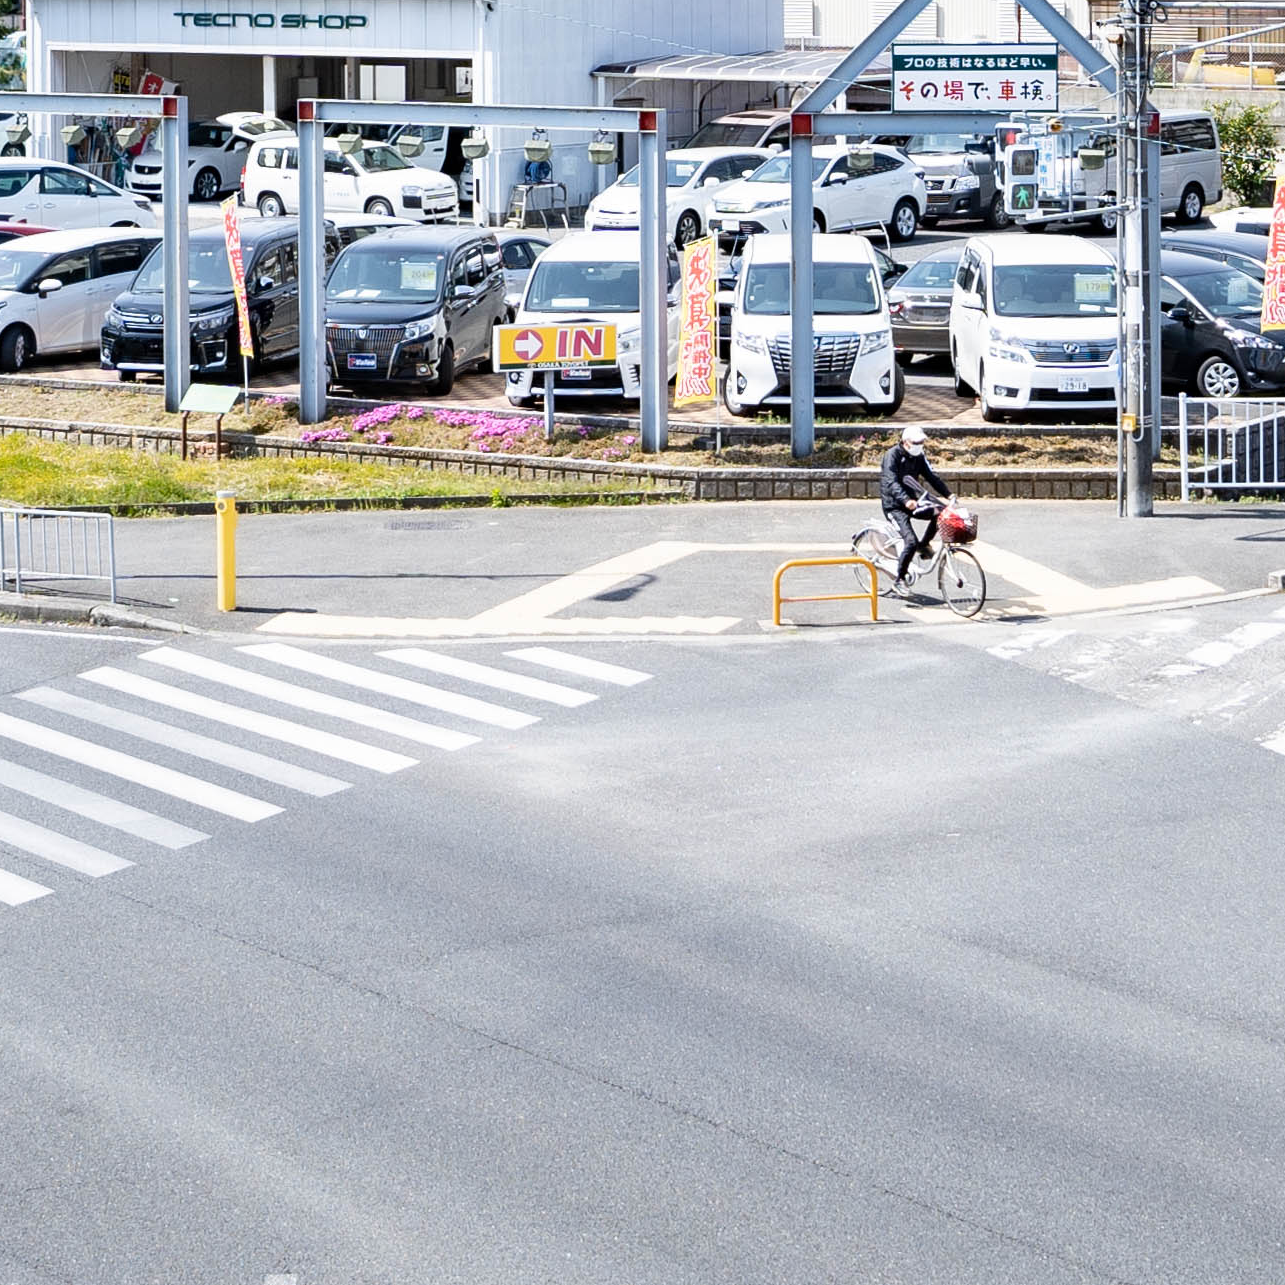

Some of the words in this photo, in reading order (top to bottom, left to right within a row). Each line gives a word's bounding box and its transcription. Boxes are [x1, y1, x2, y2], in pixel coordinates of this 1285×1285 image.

[173, 12, 276, 29] TECNO
[280, 13, 368, 30] SHOP
[903, 56, 1047, 69] プロの技術はなるほど早い。
[899, 78, 1052, 102] その場で、車検。
[558, 328, 603, 358] IN
